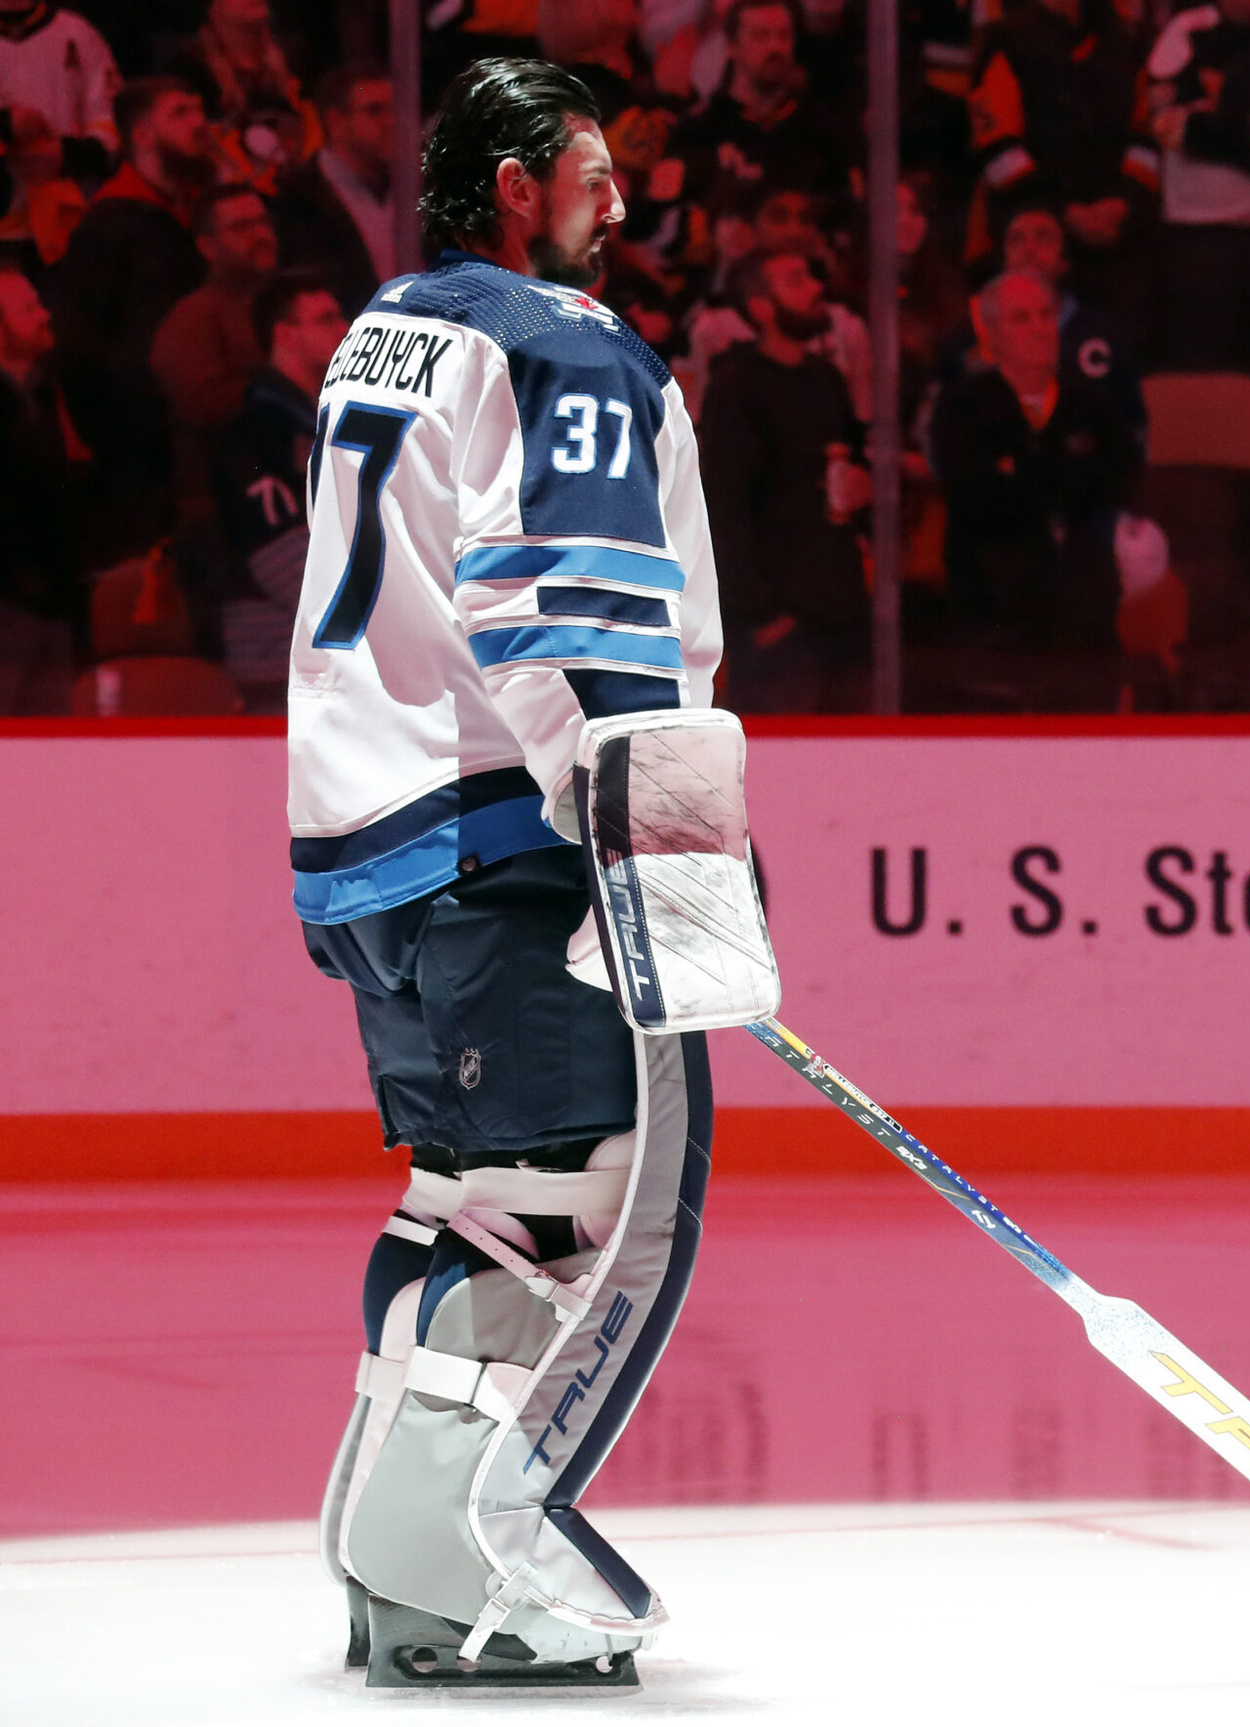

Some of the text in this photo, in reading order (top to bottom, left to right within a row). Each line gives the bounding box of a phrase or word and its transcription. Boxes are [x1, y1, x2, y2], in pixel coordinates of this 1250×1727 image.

[324, 327, 453, 398] ELEBUYCK
[1077, 337, 1113, 379] C
[551, 393, 633, 480] 37
[311, 400, 417, 650] 7
[607, 848, 650, 1001] TRUE
[868, 846, 964, 937] U.
[1008, 844, 1099, 937] S.
[905, 1134, 998, 1212] CATALYST
[523, 1291, 633, 1475] TRUE
